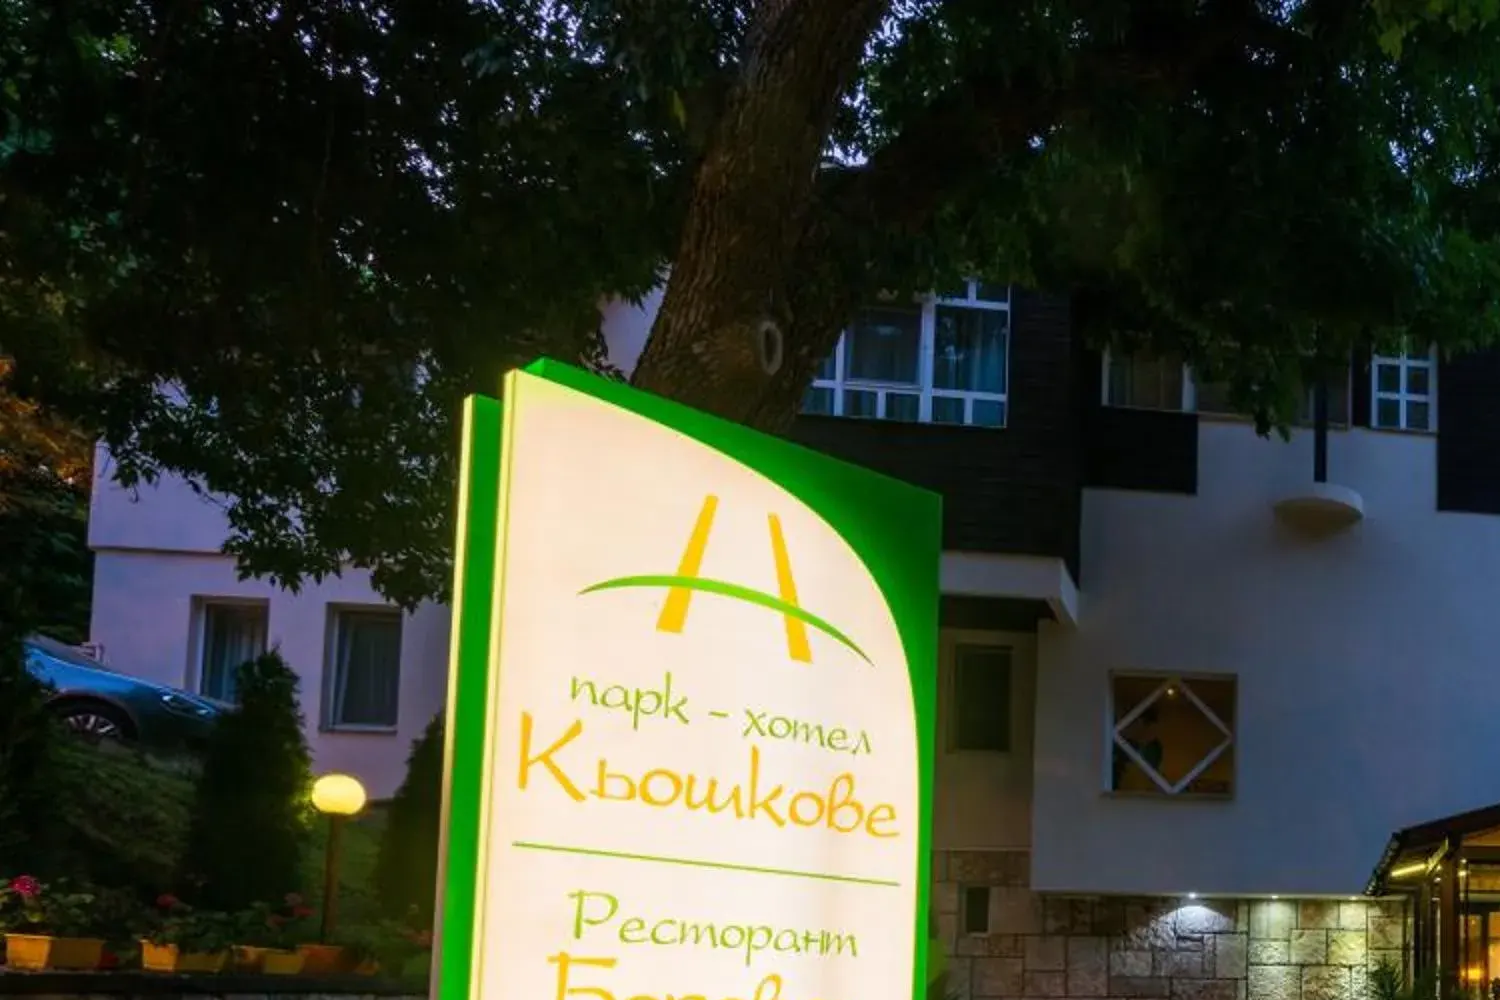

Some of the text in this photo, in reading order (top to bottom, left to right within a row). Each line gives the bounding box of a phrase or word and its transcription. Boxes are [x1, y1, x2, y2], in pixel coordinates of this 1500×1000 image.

[569, 672, 690, 729] парк
[742, 706, 873, 755] хотел
[516, 710, 902, 840] Кьошкове
[567, 888, 859, 965] Ресторант
